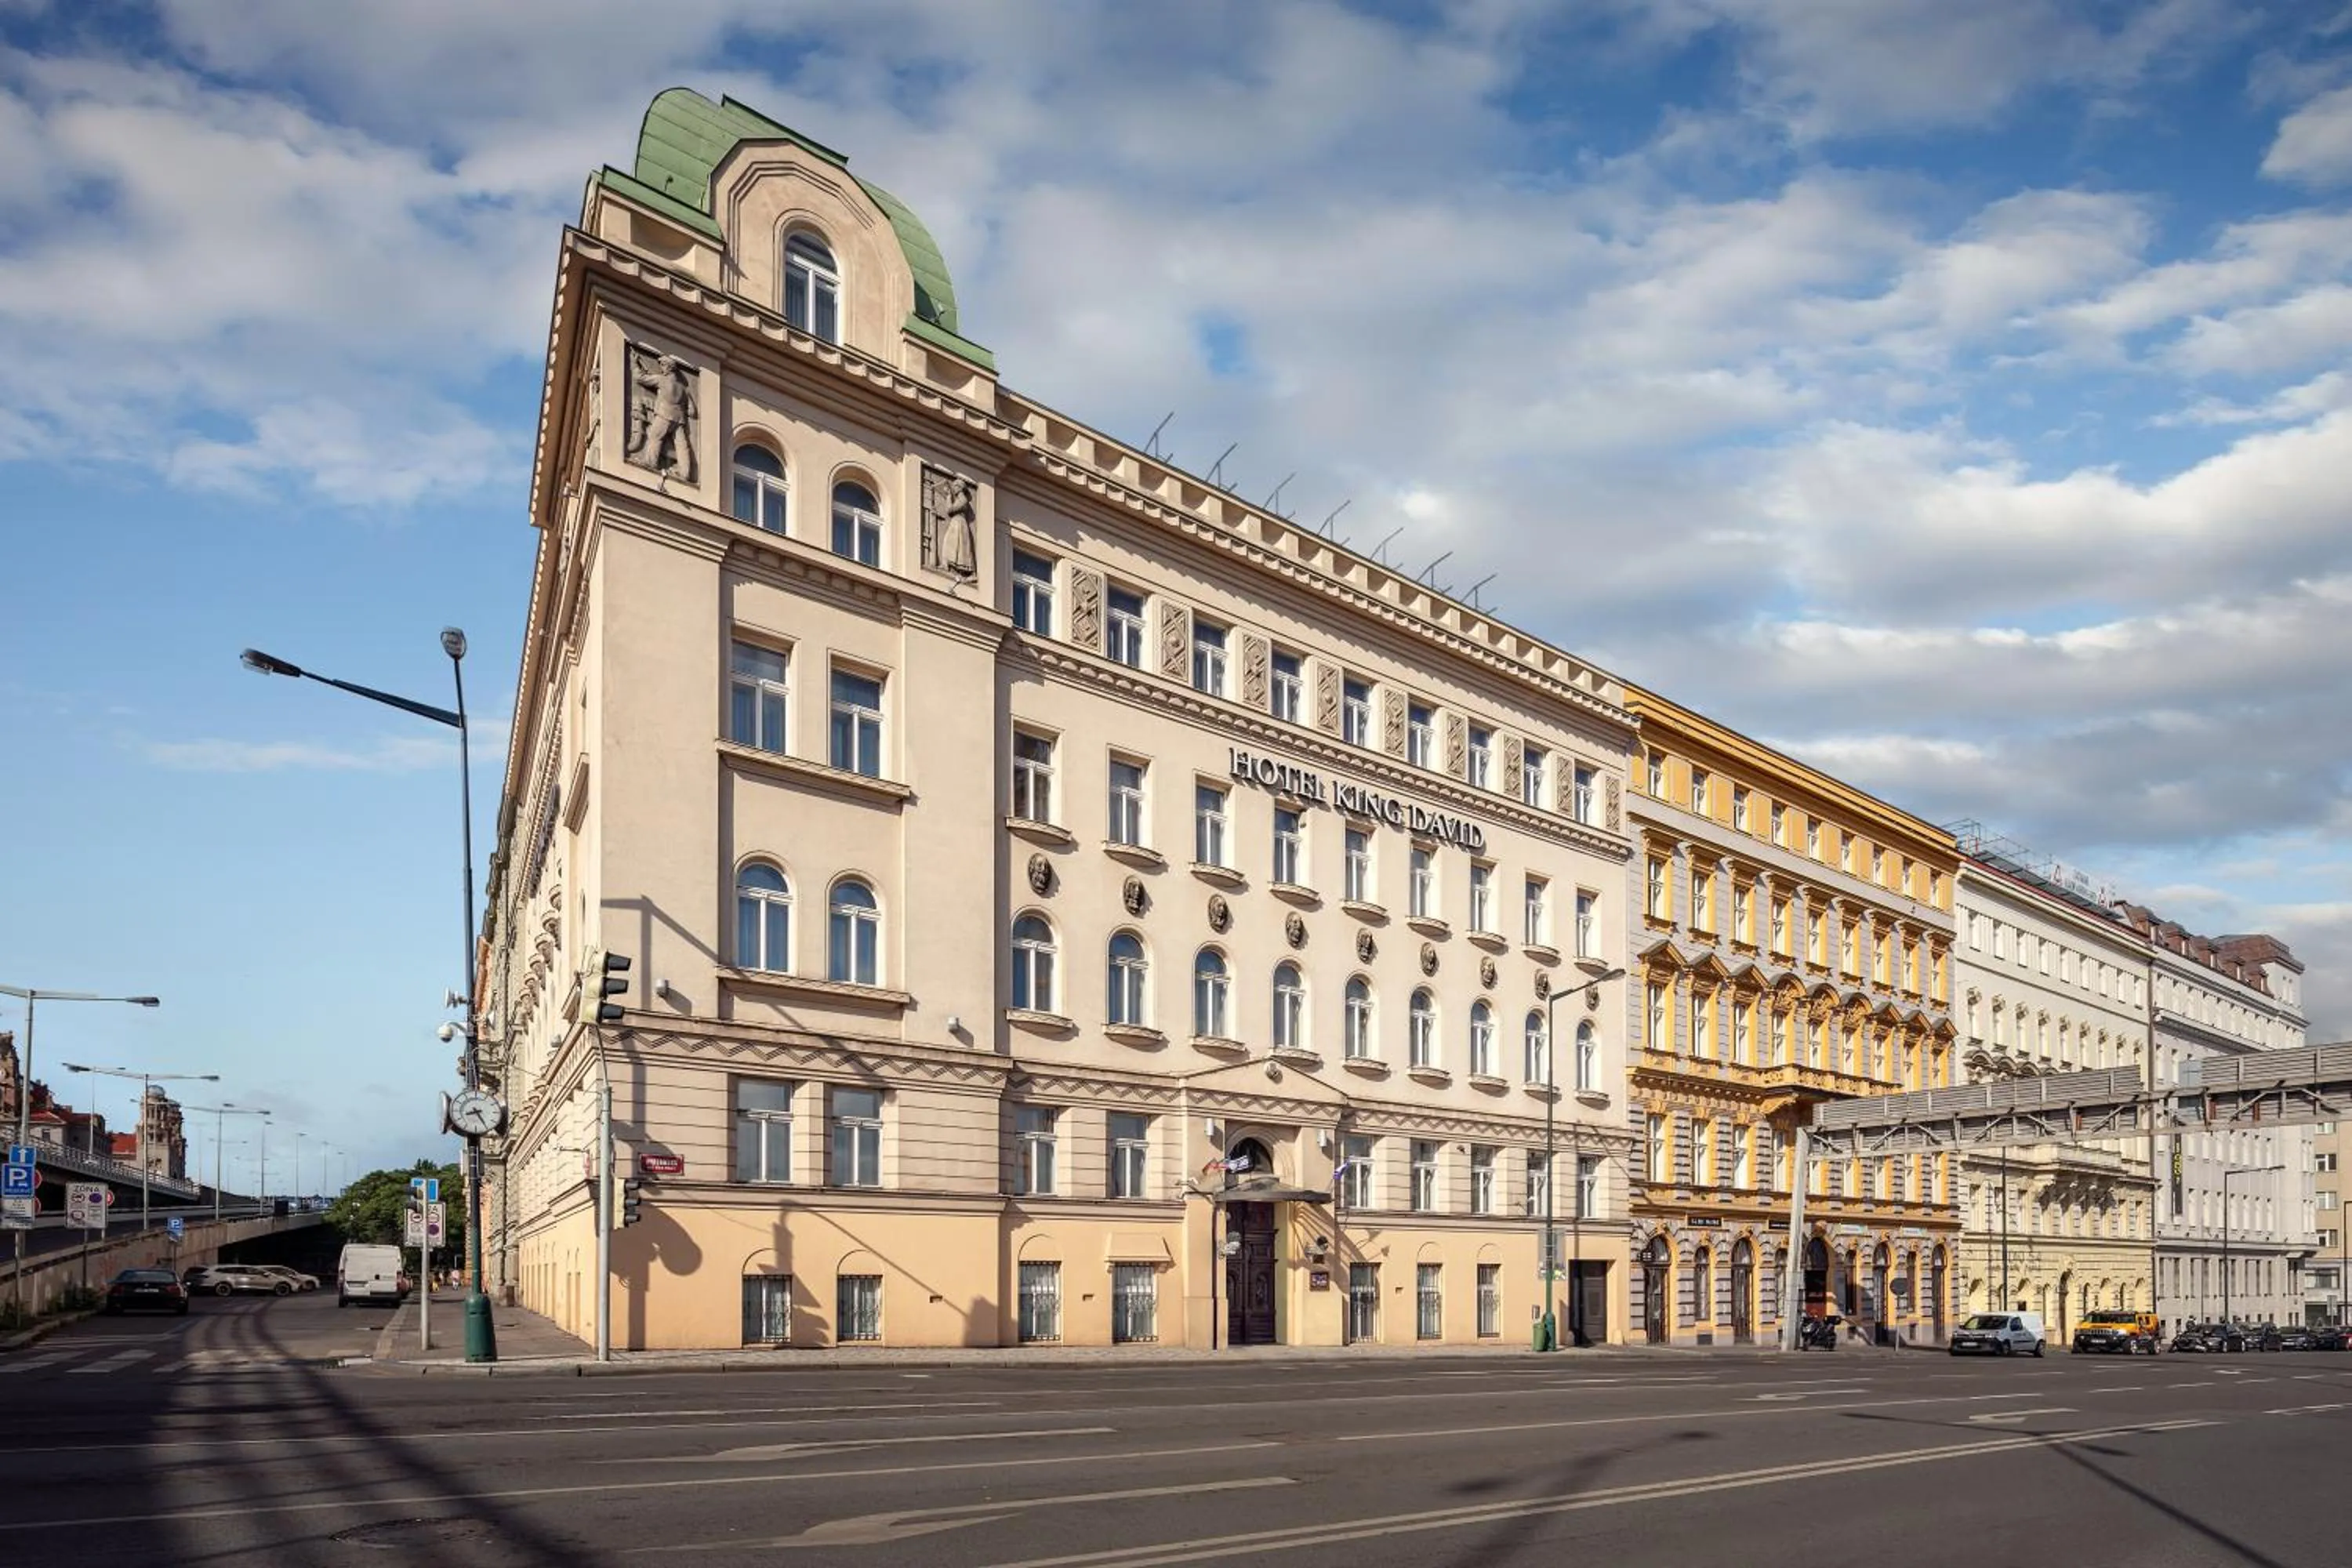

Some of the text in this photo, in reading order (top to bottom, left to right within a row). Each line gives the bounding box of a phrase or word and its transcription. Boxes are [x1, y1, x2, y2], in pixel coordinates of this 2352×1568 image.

[1229, 747, 1485, 848] HOTEL KING DAVID
[9, 1167, 27, 1187] P
